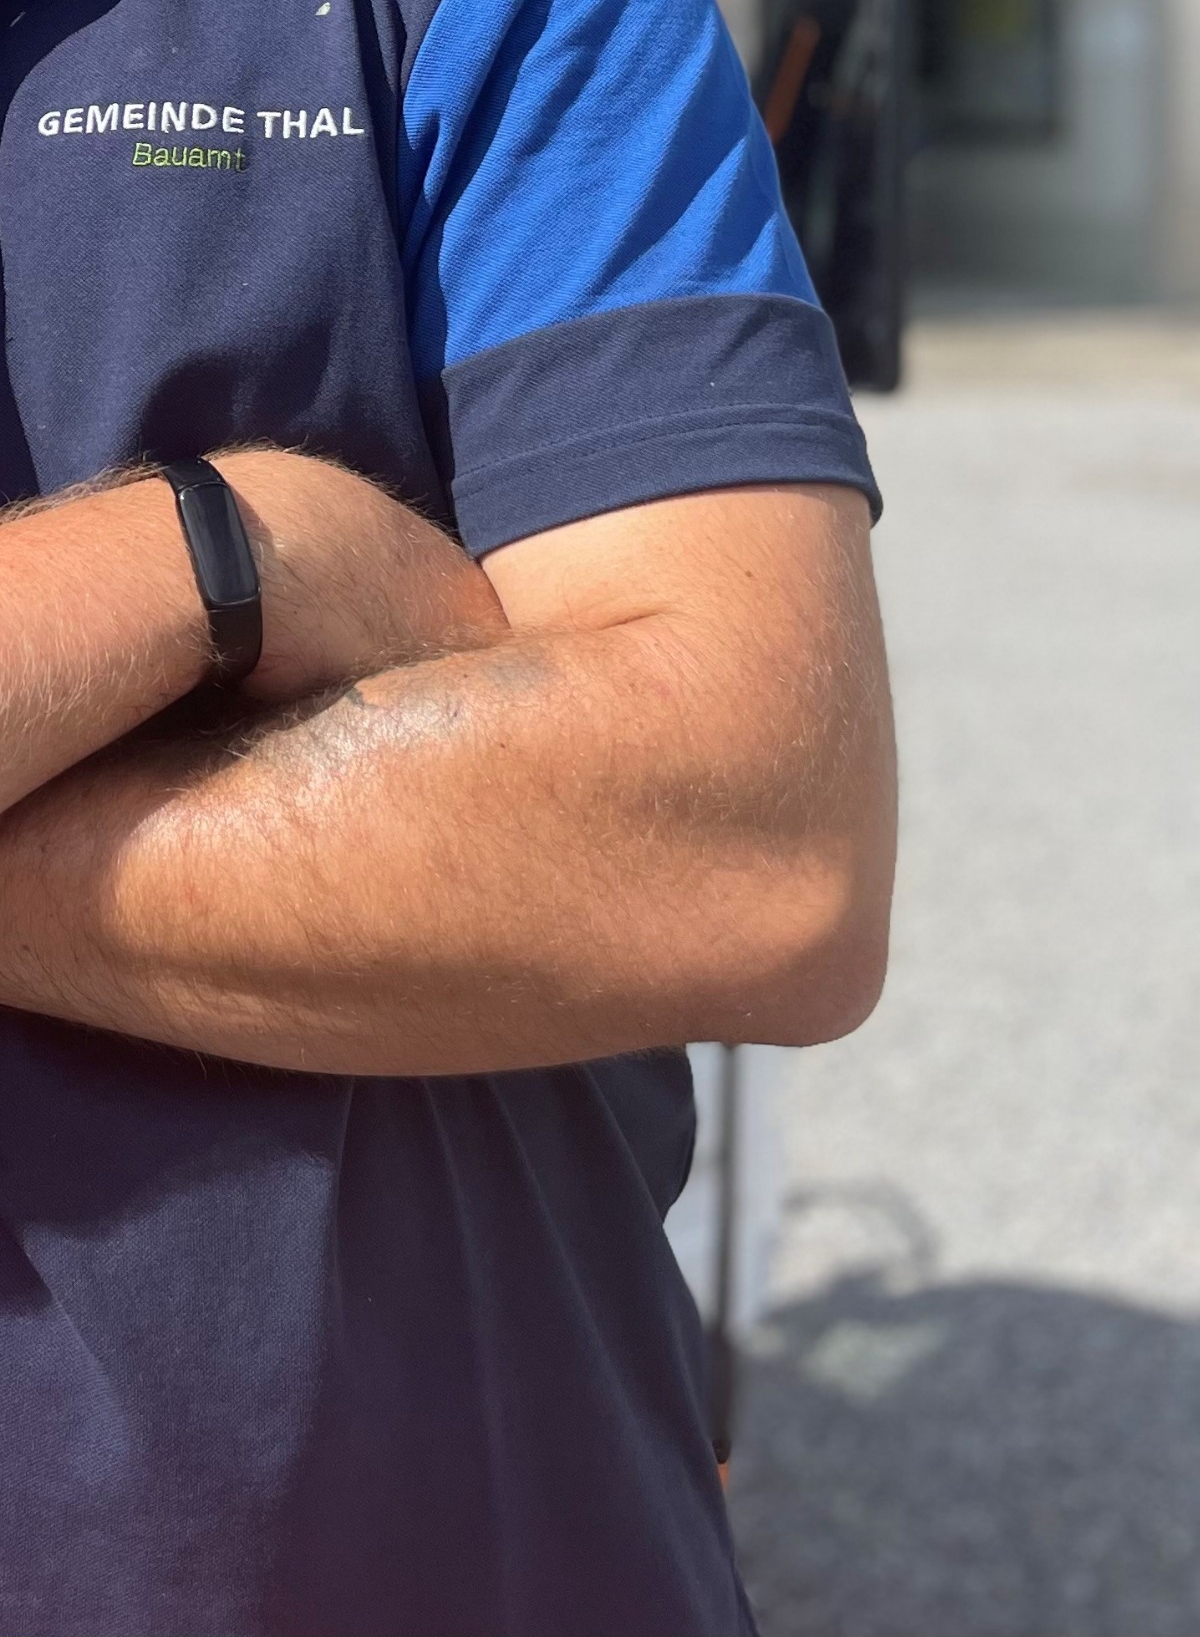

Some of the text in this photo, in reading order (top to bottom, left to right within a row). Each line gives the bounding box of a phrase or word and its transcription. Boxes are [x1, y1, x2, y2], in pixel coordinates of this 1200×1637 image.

[37, 102, 365, 139] GEMEINDE THAL
[132, 142, 247, 172] Bauamt
